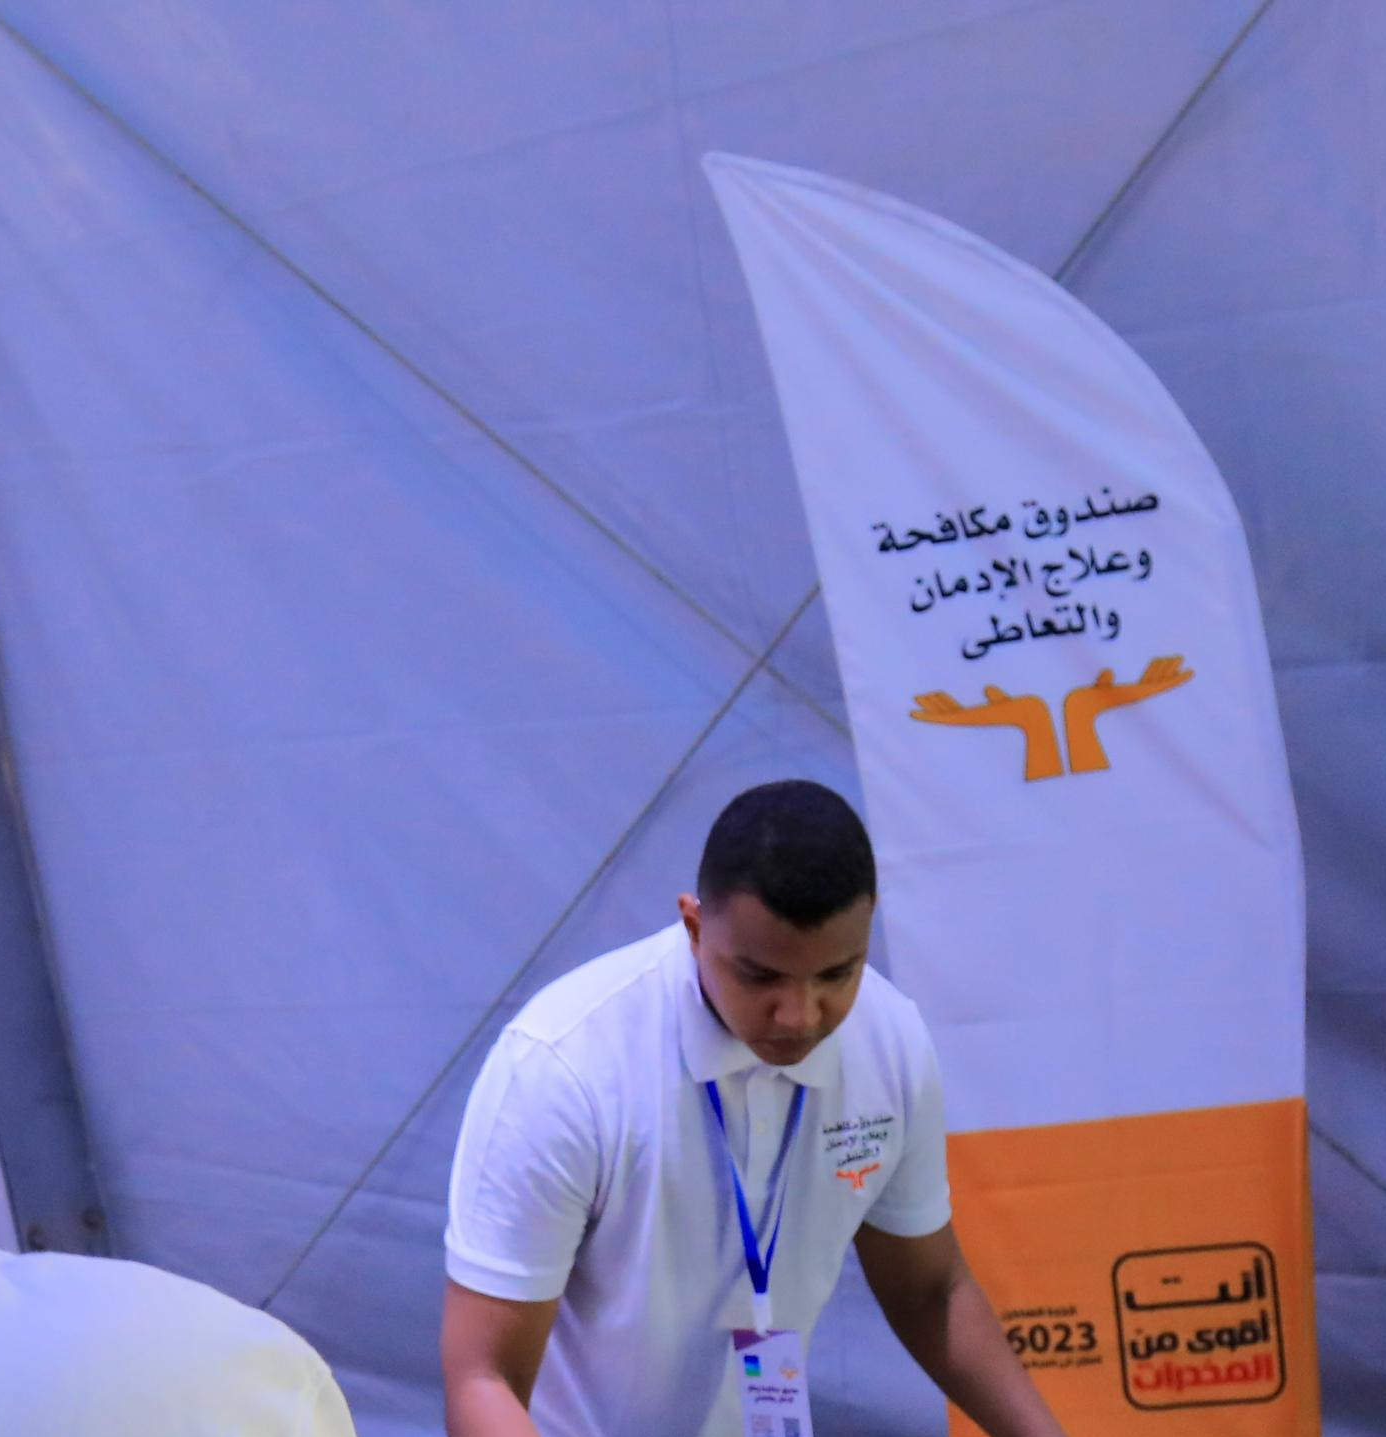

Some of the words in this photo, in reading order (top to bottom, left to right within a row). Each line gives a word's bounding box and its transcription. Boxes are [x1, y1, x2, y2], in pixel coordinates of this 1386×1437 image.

[872, 506, 1011, 554] مكافحة
[1022, 487, 1160, 540] صندوق
[1041, 546, 1154, 597] وعلاج
[1130, 1328, 1179, 1360] من
[1133, 1353, 1274, 1392] المخدرات
